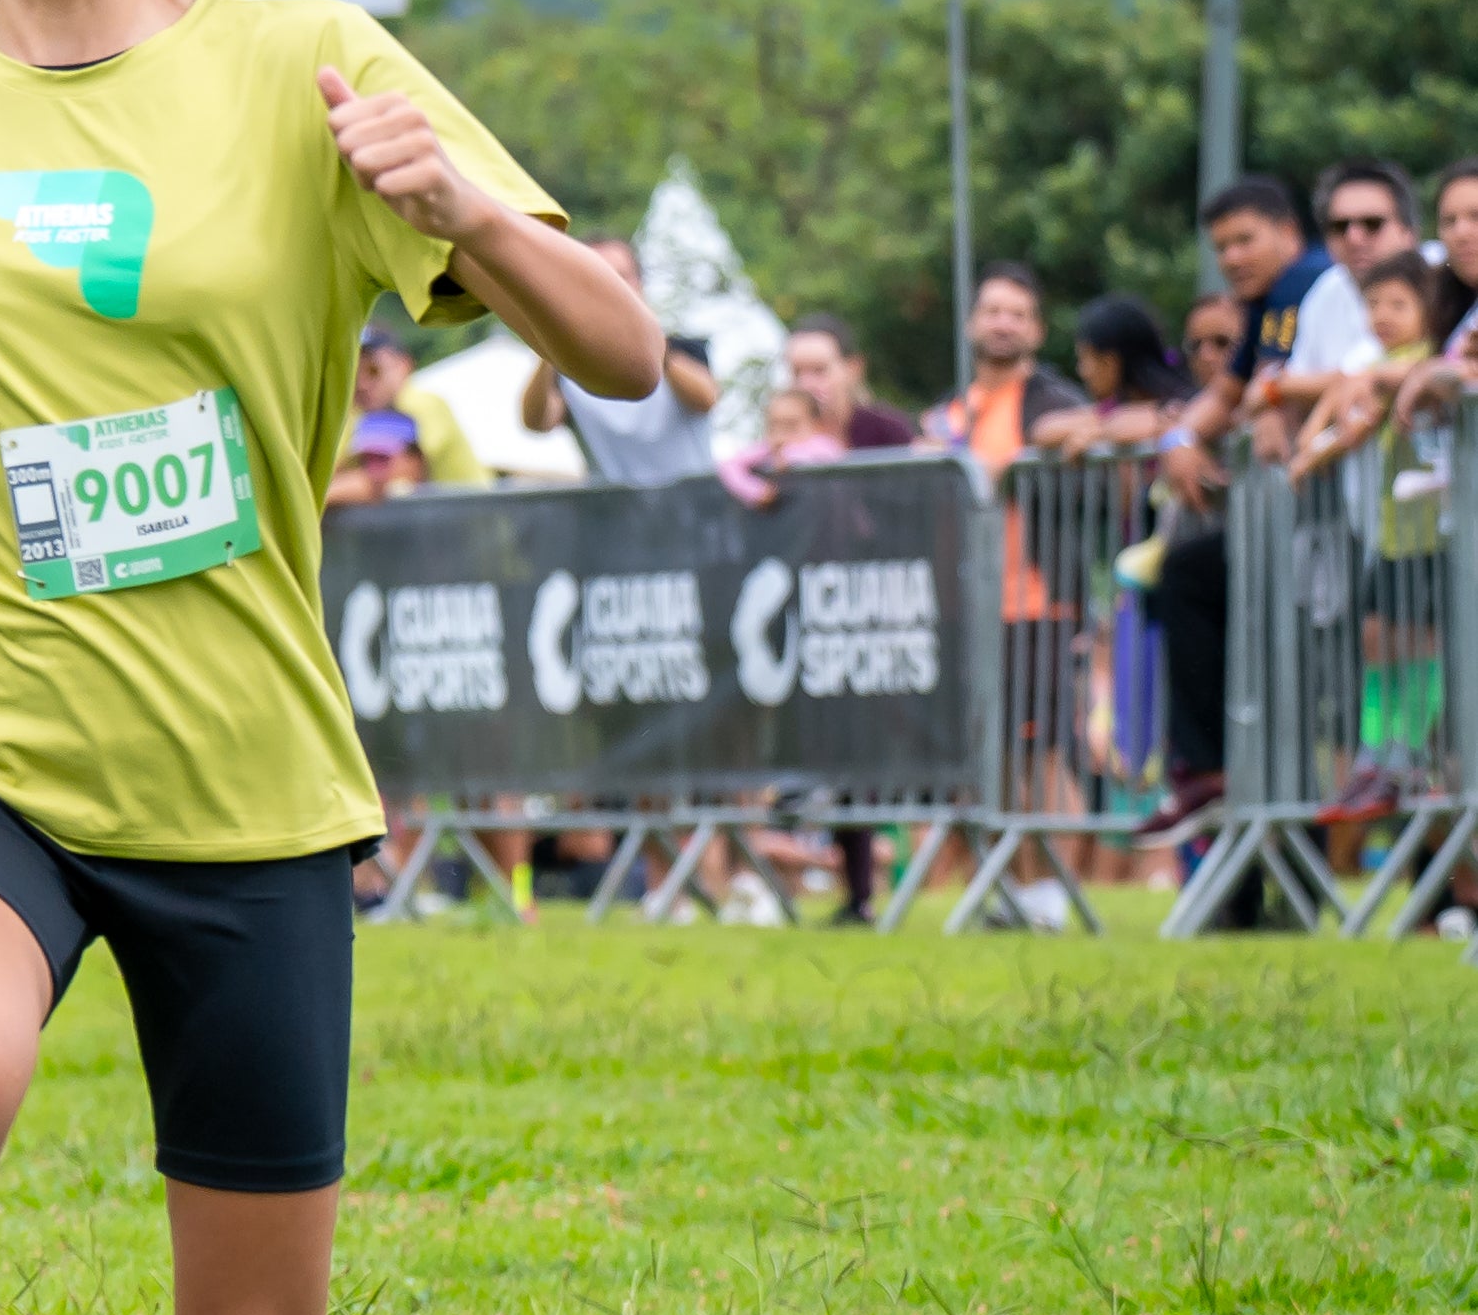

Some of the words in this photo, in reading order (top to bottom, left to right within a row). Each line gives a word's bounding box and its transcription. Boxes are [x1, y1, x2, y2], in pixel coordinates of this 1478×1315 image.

[14, 202, 116, 228] ATHENAS
[94, 409, 168, 437] ATHENAS
[7, 467, 51, 485] 300m
[73, 441, 214, 523] 9007
[136, 515, 190, 536] ISABELLA
[21, 539, 65, 561] 2013
[799, 558, 937, 624] IGUANA
[389, 648, 508, 713] SPORTS
[581, 639, 710, 702] SPORTS
[799, 628, 941, 698] SPORTS
